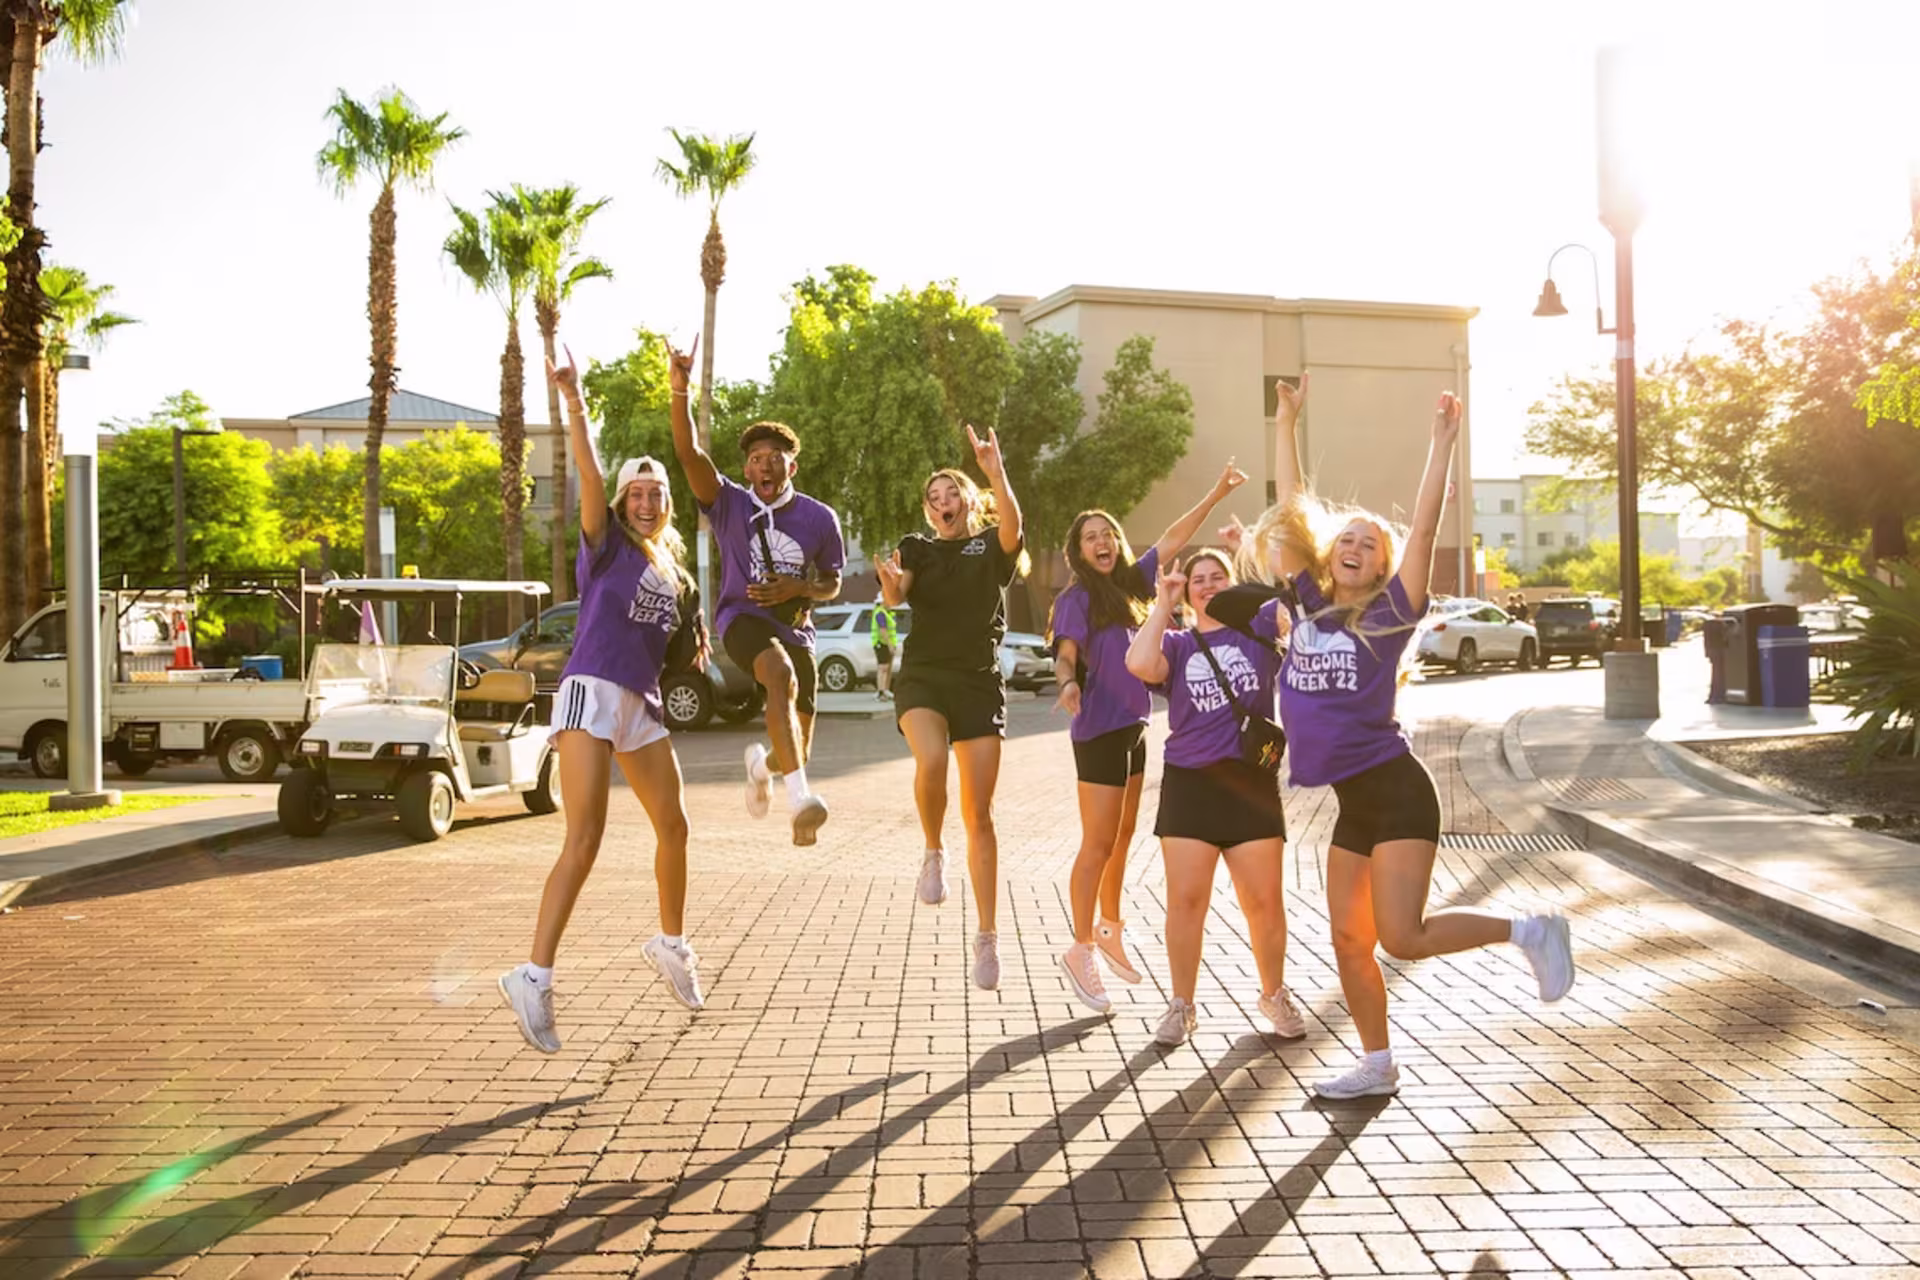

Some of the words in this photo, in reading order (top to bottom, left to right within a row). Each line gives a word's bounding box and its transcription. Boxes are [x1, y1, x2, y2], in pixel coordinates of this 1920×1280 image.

[1291, 648, 1358, 673] WELCOME
[1187, 661, 1256, 698] WELOME
[1286, 664, 1330, 692] WEEK
[1331, 670, 1358, 692] '22
